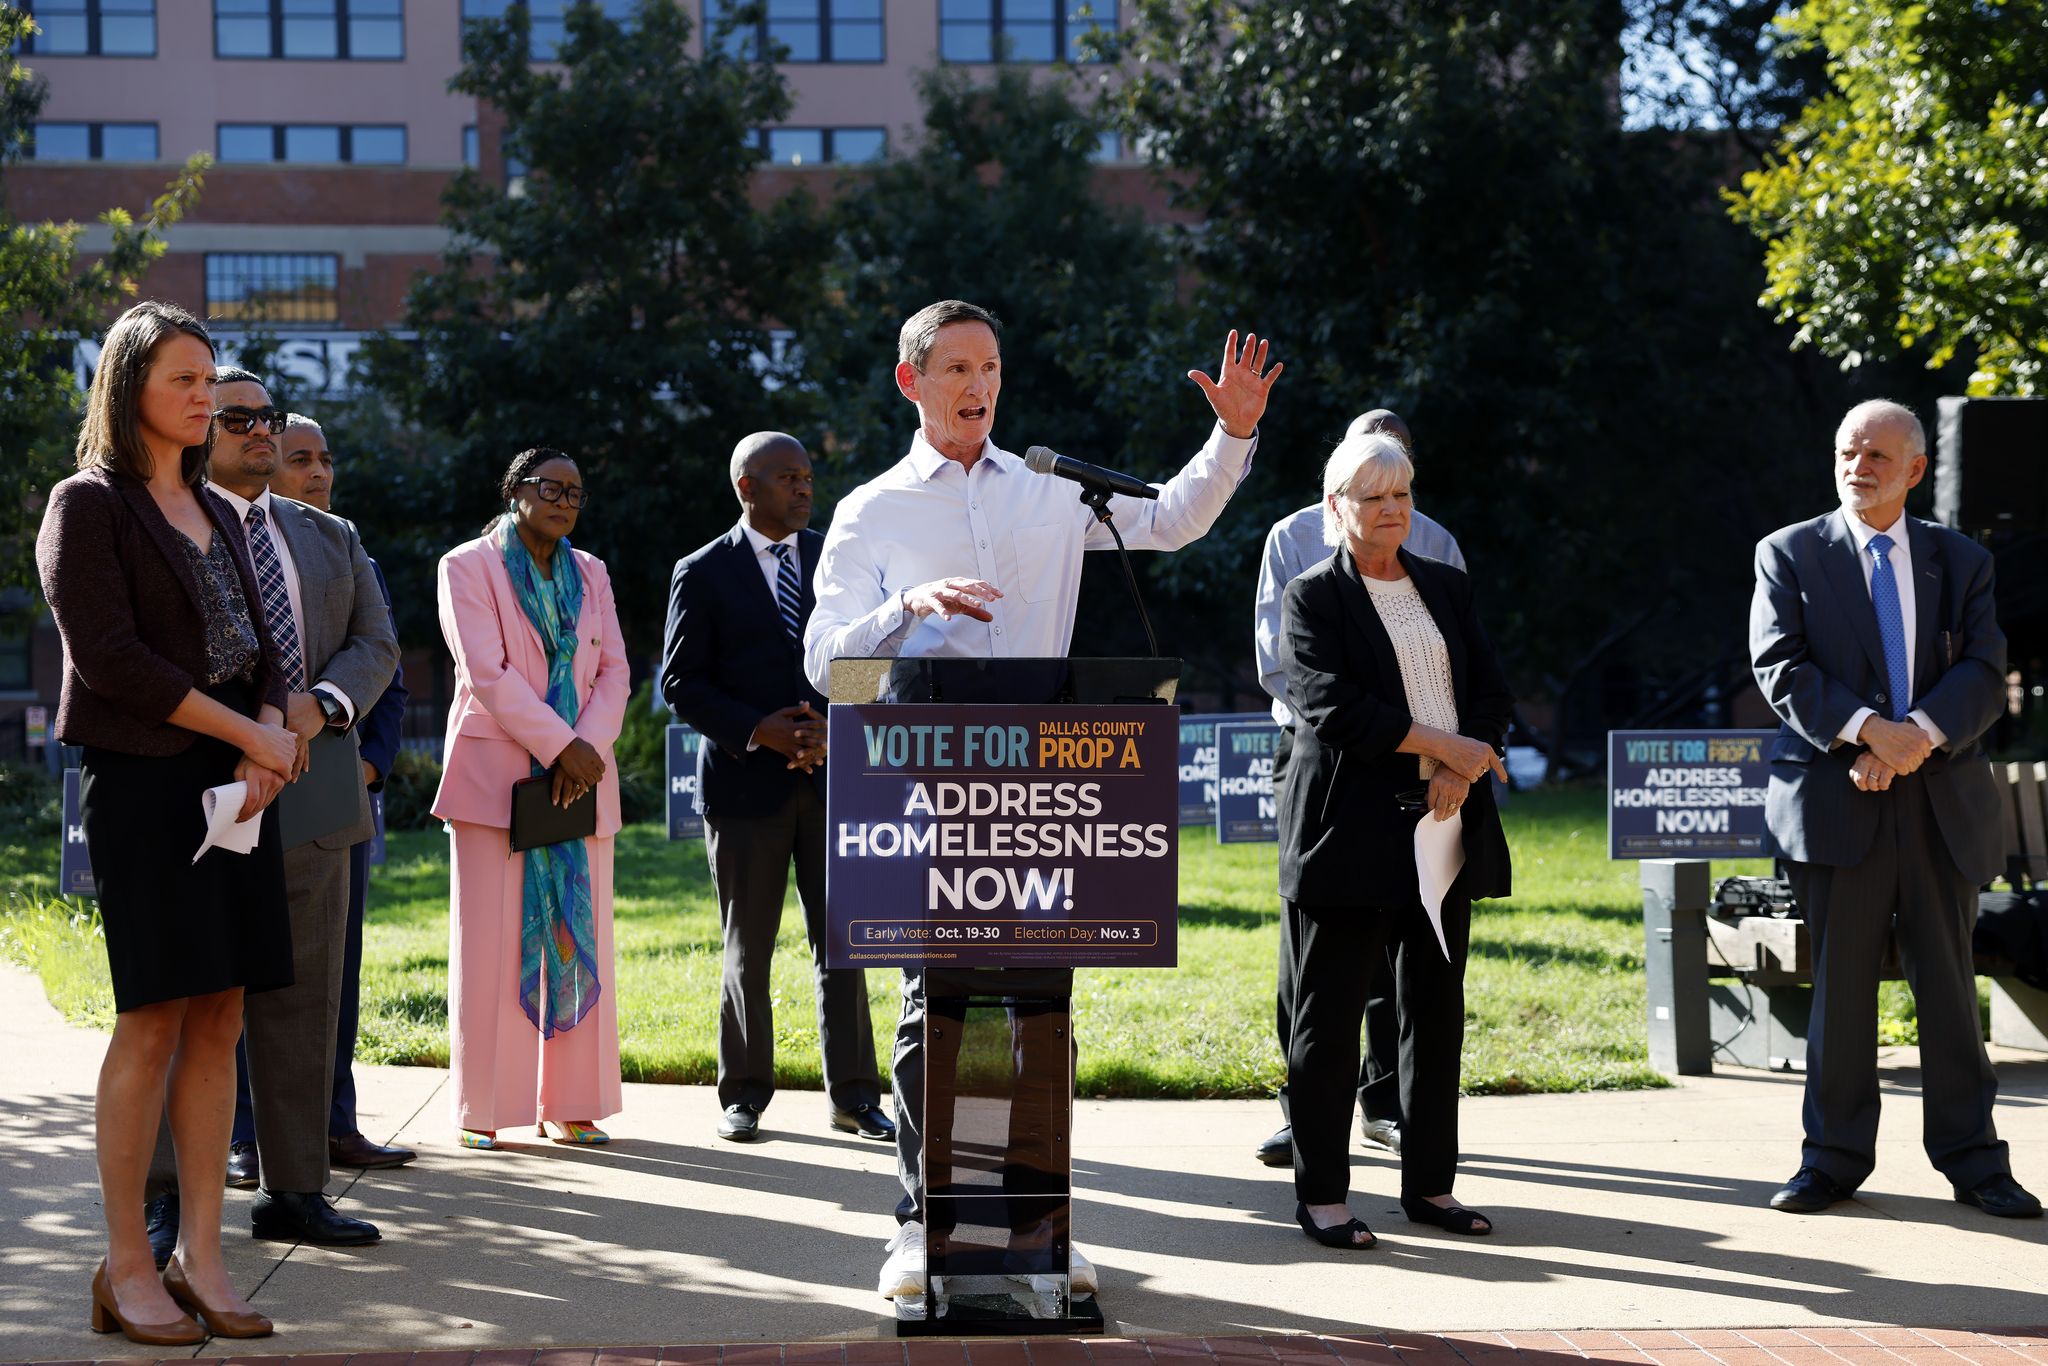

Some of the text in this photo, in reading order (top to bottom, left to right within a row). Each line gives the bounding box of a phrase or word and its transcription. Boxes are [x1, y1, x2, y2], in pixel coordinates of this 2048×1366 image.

[1039, 722, 1145, 736] DALLAS COUNTY
[864, 725, 1030, 767] VOTE FOR
[1039, 738, 1141, 769] PROP A
[1231, 732, 1270, 753] VOTE
[1626, 740, 1706, 763] VOTE FOR
[1748, 746, 1760, 762] A
[1645, 768, 1742, 787] ADDRESS
[904, 782, 1102, 817] ADDRESS
[1656, 809, 1729, 833] NOW!
[838, 823, 1169, 858] HOMELESSNESS
[928, 867, 1074, 910] NOW!
[866, 927, 1141, 941] Early Vote: Oct. 19-30 Election Day: Nov. 3
